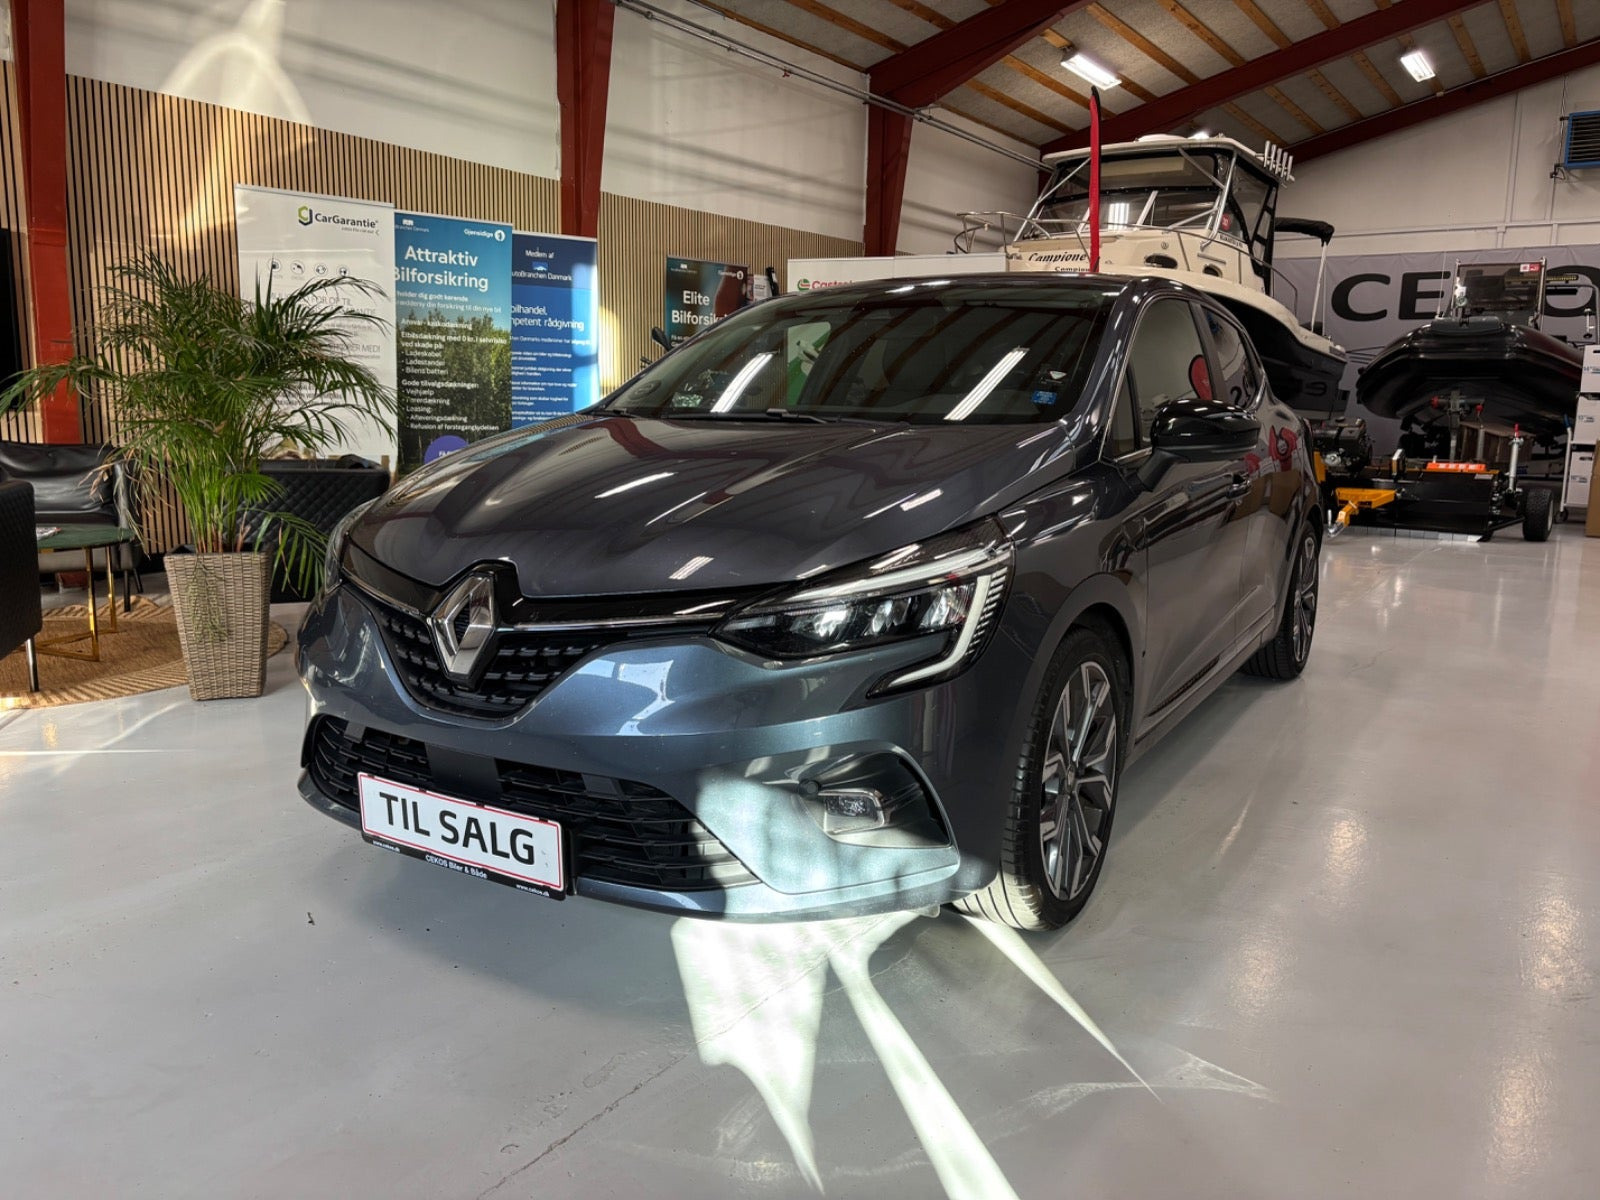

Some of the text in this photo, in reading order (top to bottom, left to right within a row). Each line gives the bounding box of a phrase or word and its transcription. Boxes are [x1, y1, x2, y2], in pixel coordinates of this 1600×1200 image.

[404, 245, 479, 267] Attraktiv
[1028, 252, 1088, 263] Campione
[682, 290, 711, 306] Elite
[379, 791, 535, 866] TIL SALG
